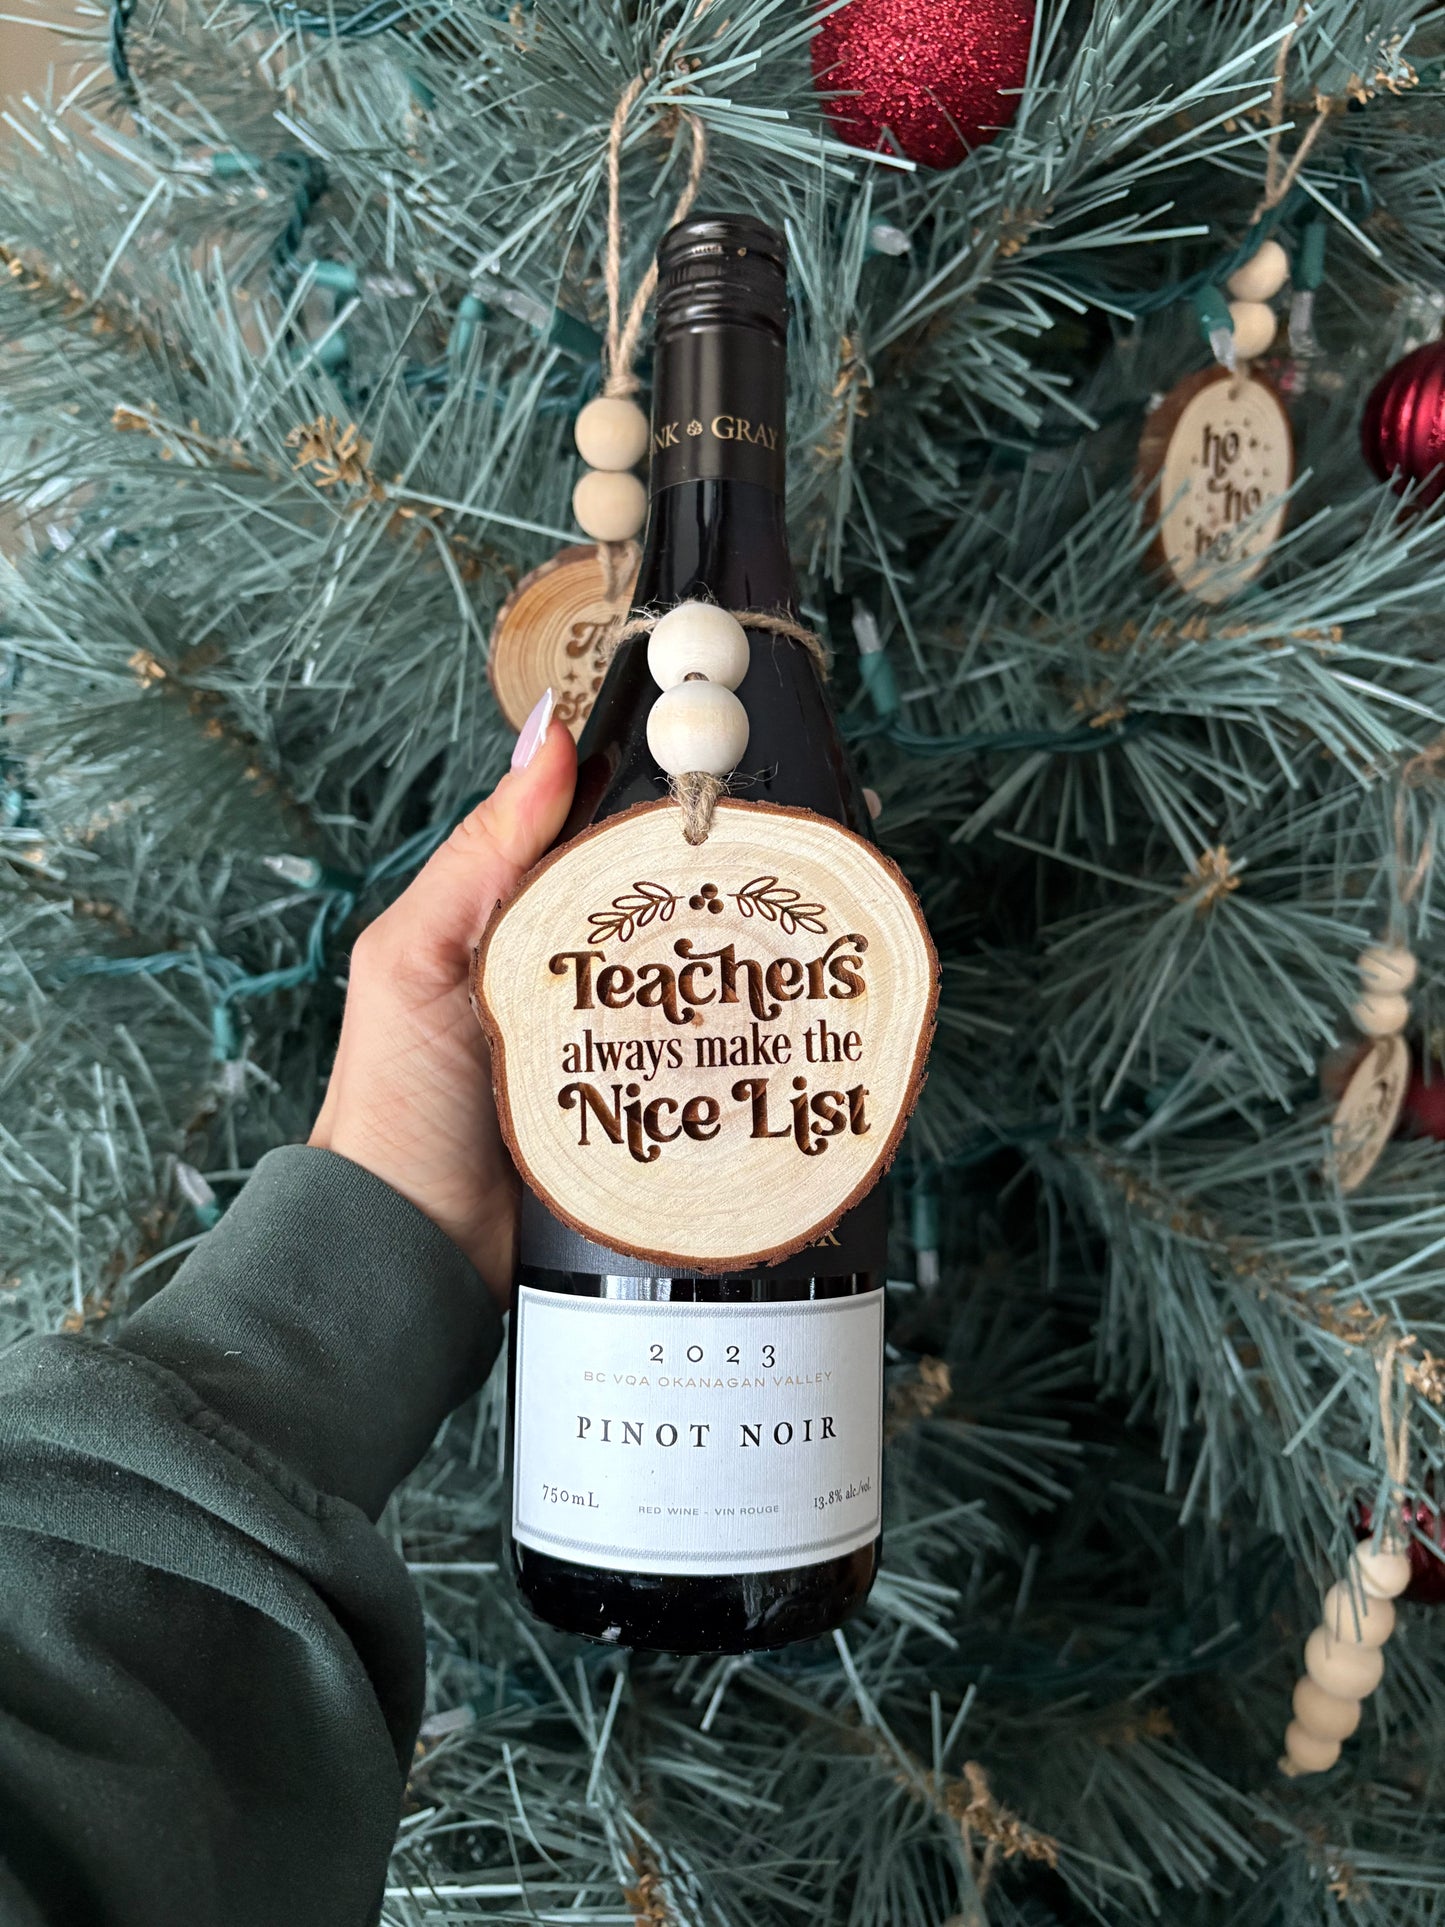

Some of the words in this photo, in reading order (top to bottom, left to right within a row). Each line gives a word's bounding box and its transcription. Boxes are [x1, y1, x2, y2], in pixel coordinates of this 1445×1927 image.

[711, 415, 778, 450] GRAY
[1202, 422, 1239, 478] ho
[549, 933, 869, 1025] Teachers
[561, 1029, 684, 1081] always
[695, 1022, 792, 1068] make
[802, 1019, 863, 1063] the
[557, 1081, 721, 1163] Nice
[731, 1076, 871, 1156] List
[583, 1370, 606, 1383] BC
[613, 1373, 650, 1386] VQA
[658, 1376, 765, 1389] OKANAGAN
[773, 1371, 832, 1387] VALLEY
[576, 1415, 710, 1448] PINOT
[738, 1416, 837, 1448] NOIR
[542, 1484, 600, 1509] 750mL
[638, 1505, 662, 1515] RED
[667, 1507, 699, 1516] WINE
[714, 1507, 735, 1516] VIN
[740, 1505, 779, 1515] ROUGE
[813, 1489, 843, 1511] 13.8%
